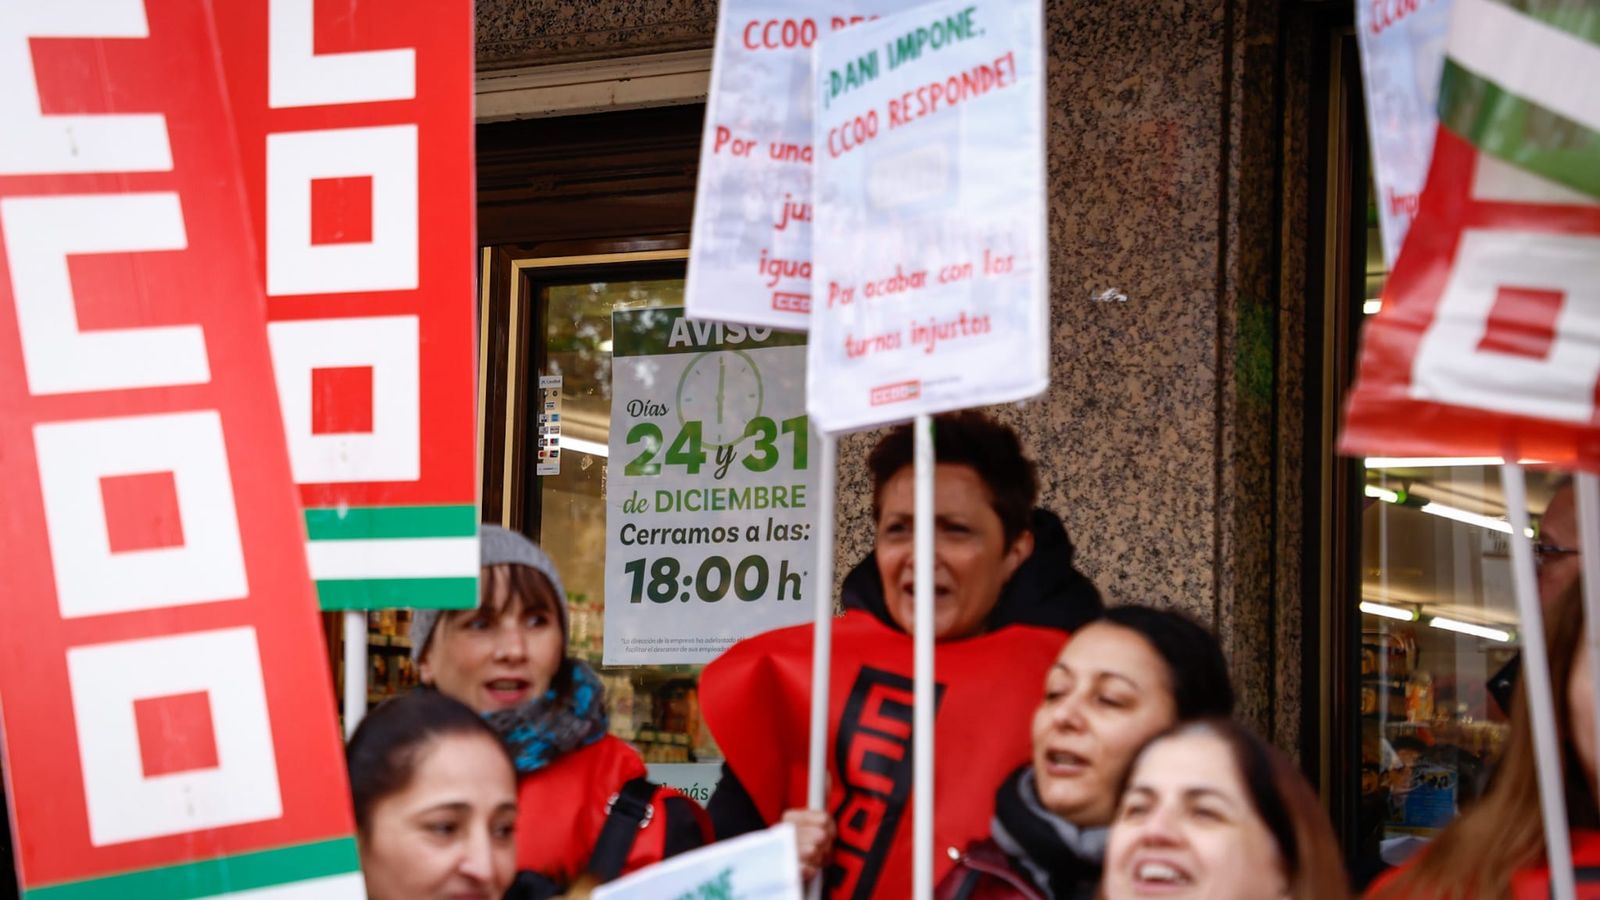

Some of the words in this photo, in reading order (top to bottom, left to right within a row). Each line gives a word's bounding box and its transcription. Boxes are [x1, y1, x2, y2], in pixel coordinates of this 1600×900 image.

[743, 17, 817, 50] CCOO
[886, 6, 985, 71] IMPONE.
[714, 125, 756, 157] Por
[827, 108, 879, 159] CCOO
[827, 279, 856, 308] Por
[864, 264, 928, 300] acabar
[937, 262, 972, 284] con
[982, 248, 1015, 275] los
[845, 333, 902, 359] turnos
[910, 311, 991, 354] injustos
[626, 398, 670, 418] Días
[624, 420, 707, 477] 24
[713, 444, 738, 480] y
[742, 415, 809, 473] 31
[623, 489, 650, 514] de
[655, 485, 807, 513] DICIEMBRE
[620, 522, 739, 546] Cerramos
[745, 526, 761, 542] a
[766, 517, 811, 542] las:
[624, 555, 770, 604] 18:00
